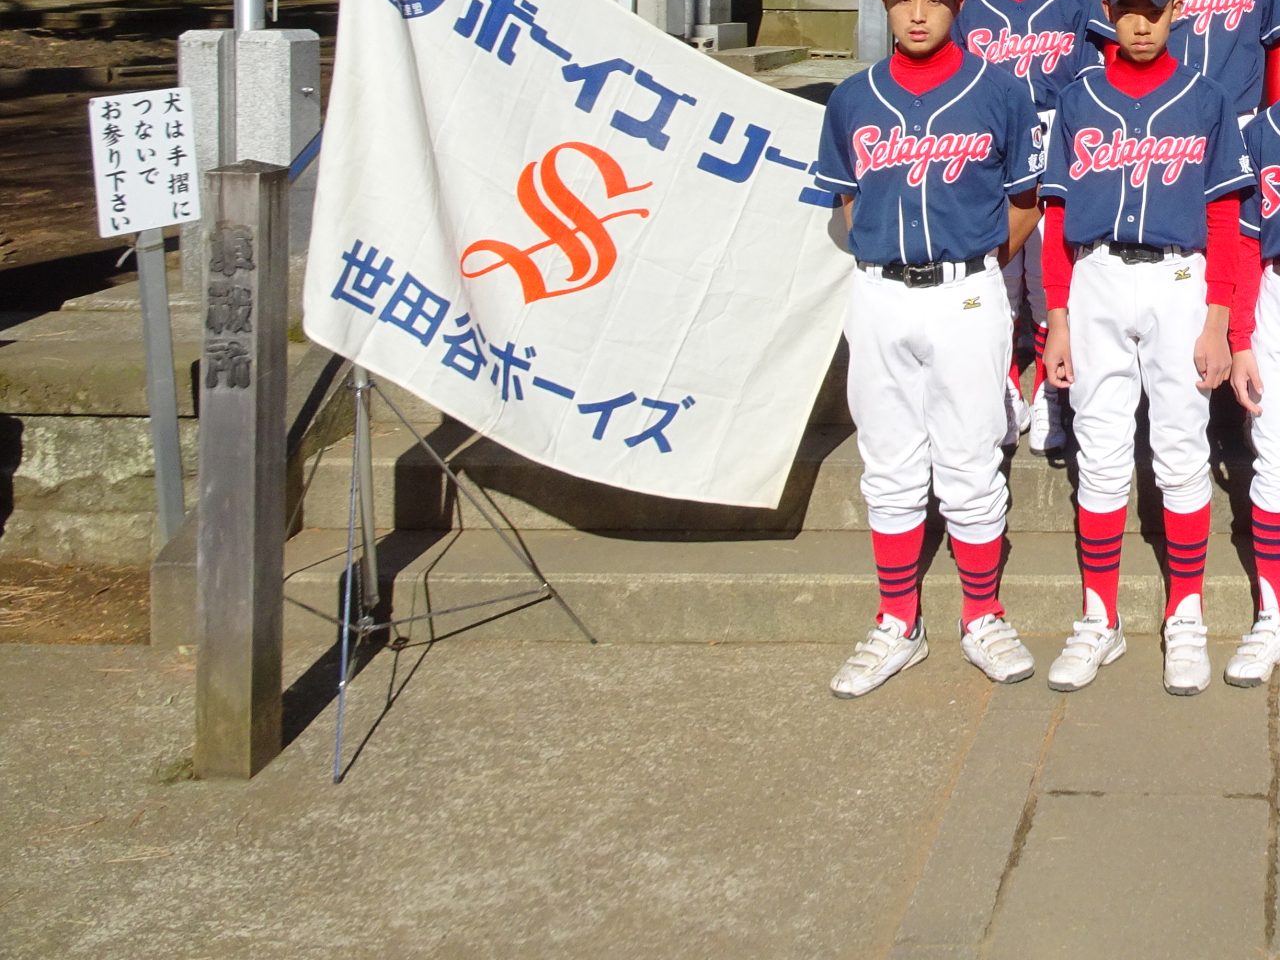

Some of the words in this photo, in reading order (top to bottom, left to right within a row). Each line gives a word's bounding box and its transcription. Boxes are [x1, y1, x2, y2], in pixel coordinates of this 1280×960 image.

[967, 27, 1076, 78] Setagaya
[101, 101, 131, 231] お参り下さい
[132, 99, 161, 185] つないで
[162, 92, 192, 220] 犬は手摺に
[853, 125, 993, 187] Setagaya
[1069, 127, 1207, 188] Setagaya
[460, 141, 654, 305] S
[331, 239, 696, 453] 世田谷ボーイズ
